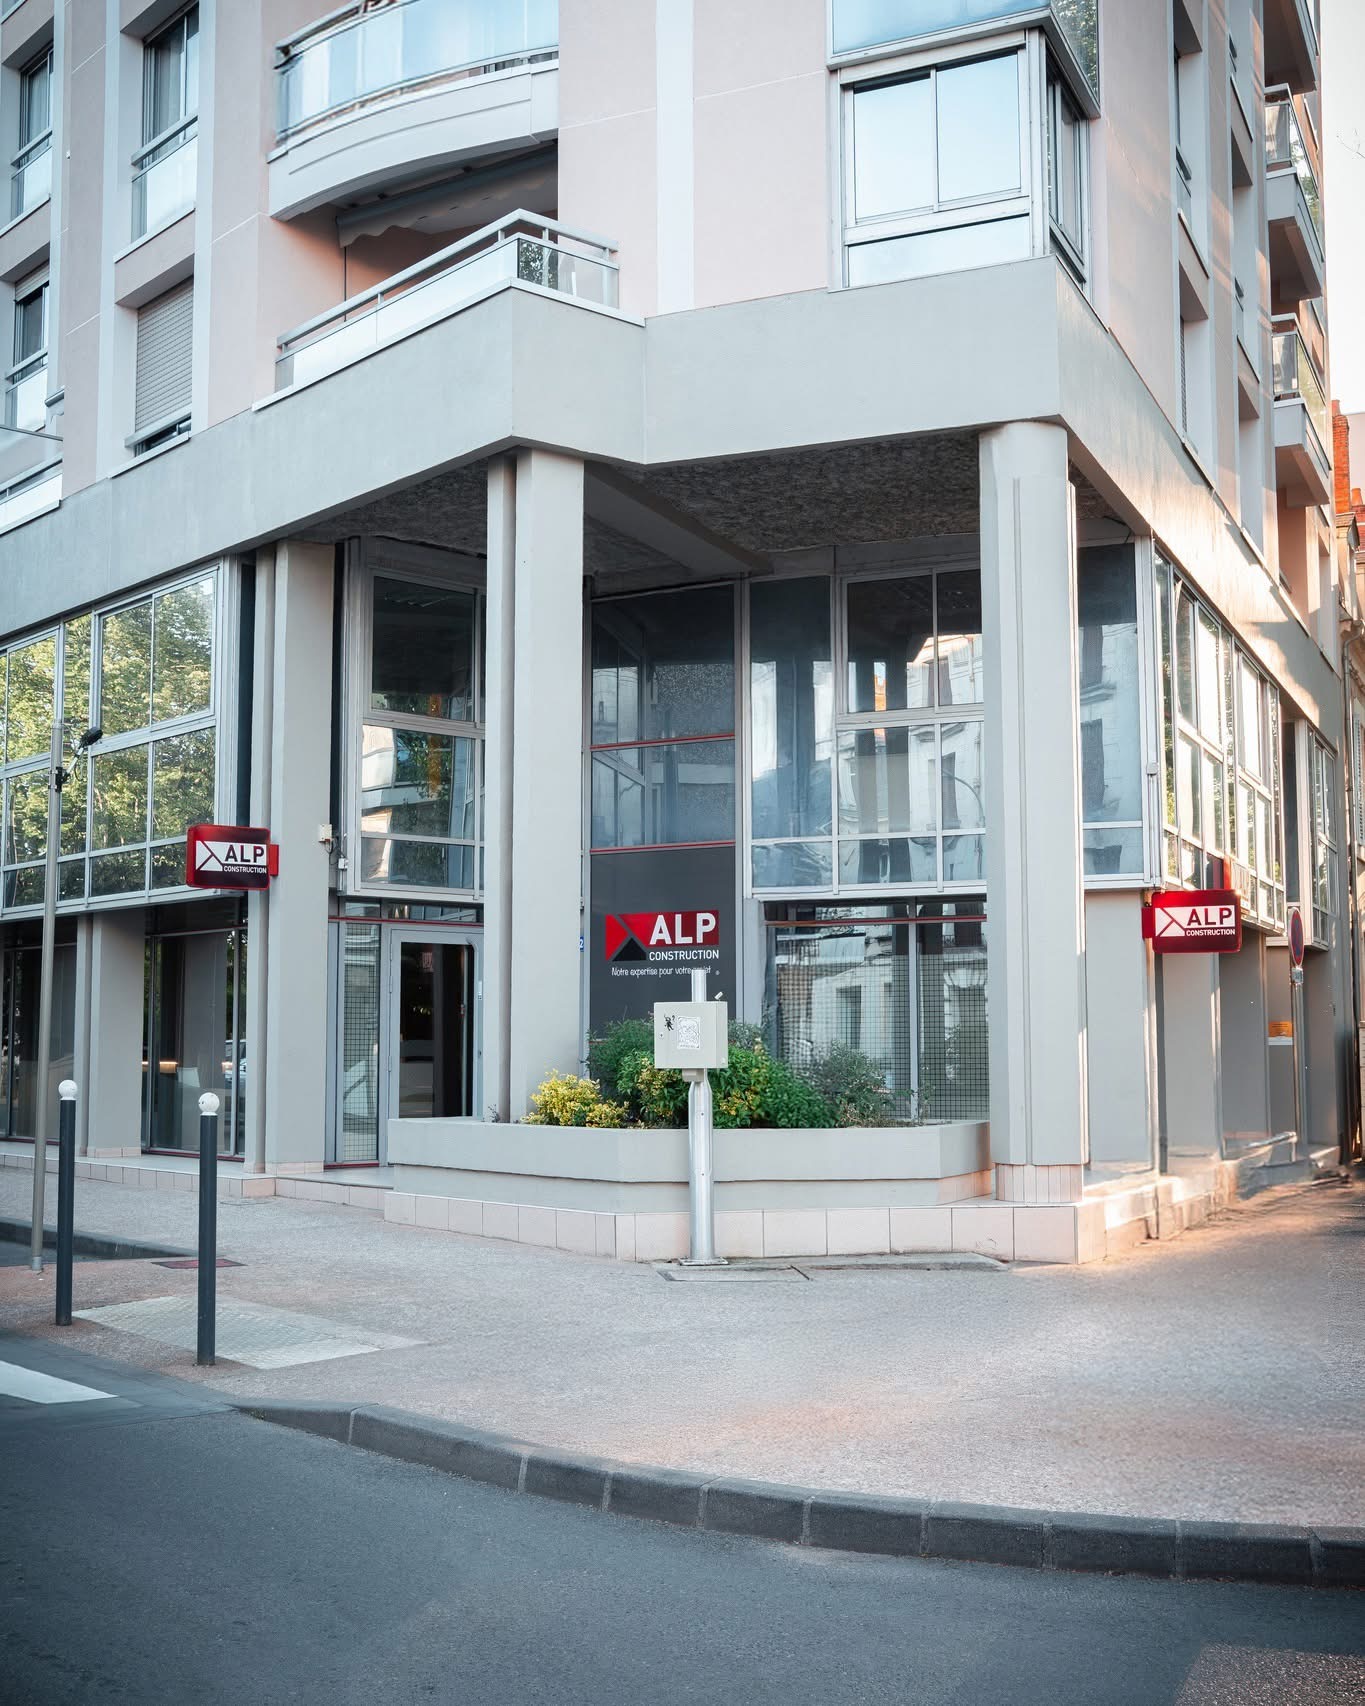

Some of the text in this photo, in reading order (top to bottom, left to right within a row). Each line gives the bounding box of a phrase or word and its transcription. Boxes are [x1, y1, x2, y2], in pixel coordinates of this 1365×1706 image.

[225, 844, 264, 863] ALP
[224, 865, 267, 873] CONSTRUCTION
[1187, 907, 1232, 926] ALP
[649, 912, 716, 945] ALP
[649, 949, 719, 961] CONSTRUCTION
[611, 967, 629, 976] Notre
[630, 967, 657, 978] expertise
[659, 968, 673, 977] pour
[675, 966, 692, 975] votre
